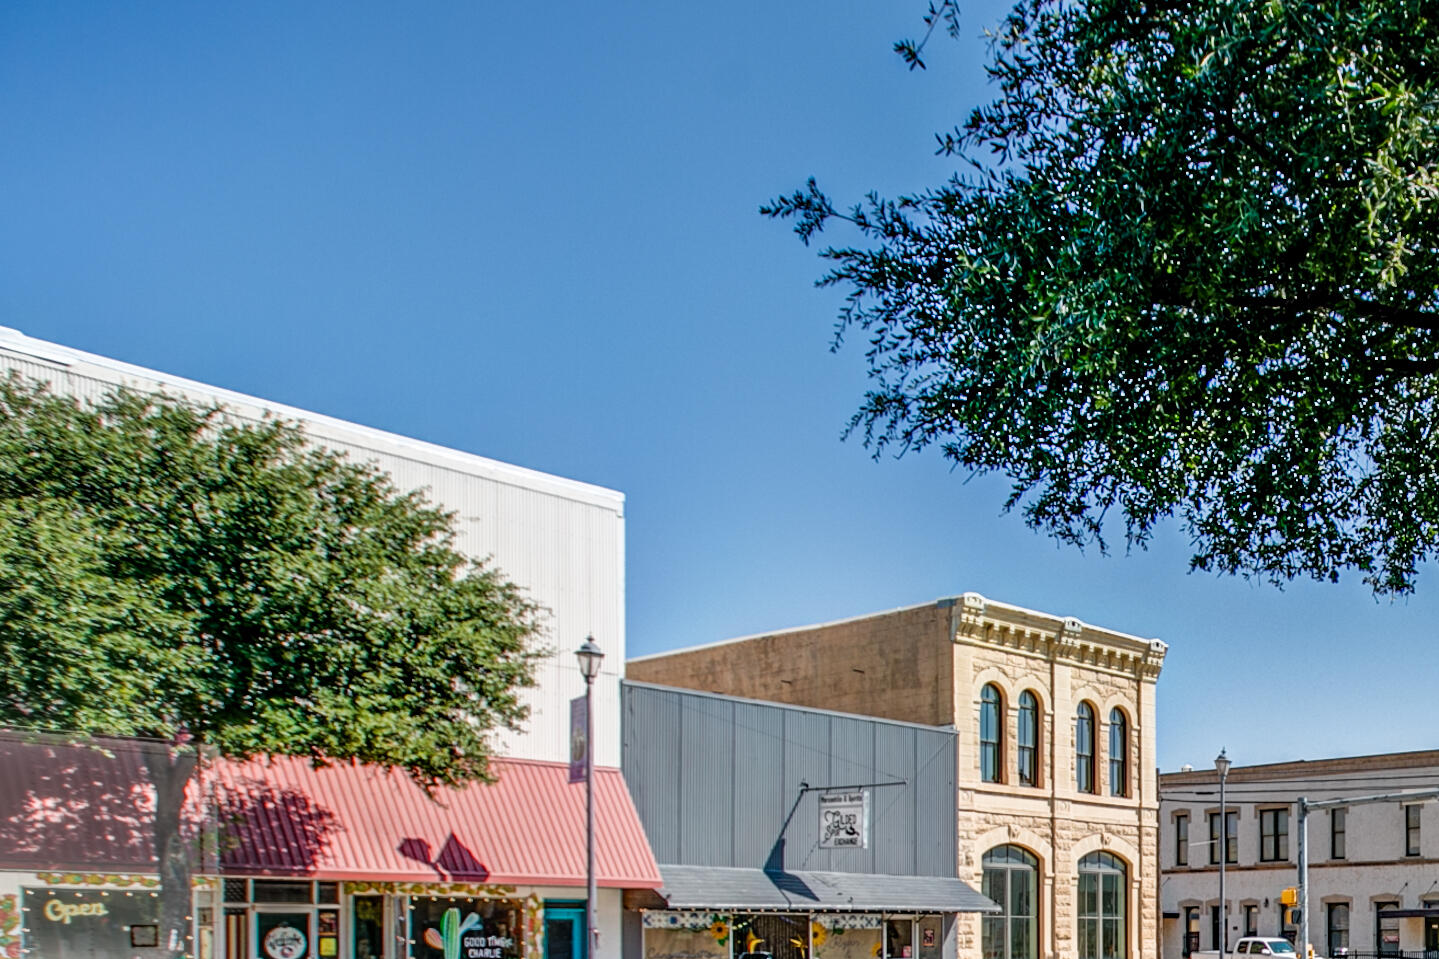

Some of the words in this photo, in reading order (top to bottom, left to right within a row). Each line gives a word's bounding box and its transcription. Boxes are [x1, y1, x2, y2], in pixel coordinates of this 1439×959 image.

[43, 899, 109, 925] Open
[464, 936, 486, 948] GOOD
[468, 948, 502, 959] CHARLIE
